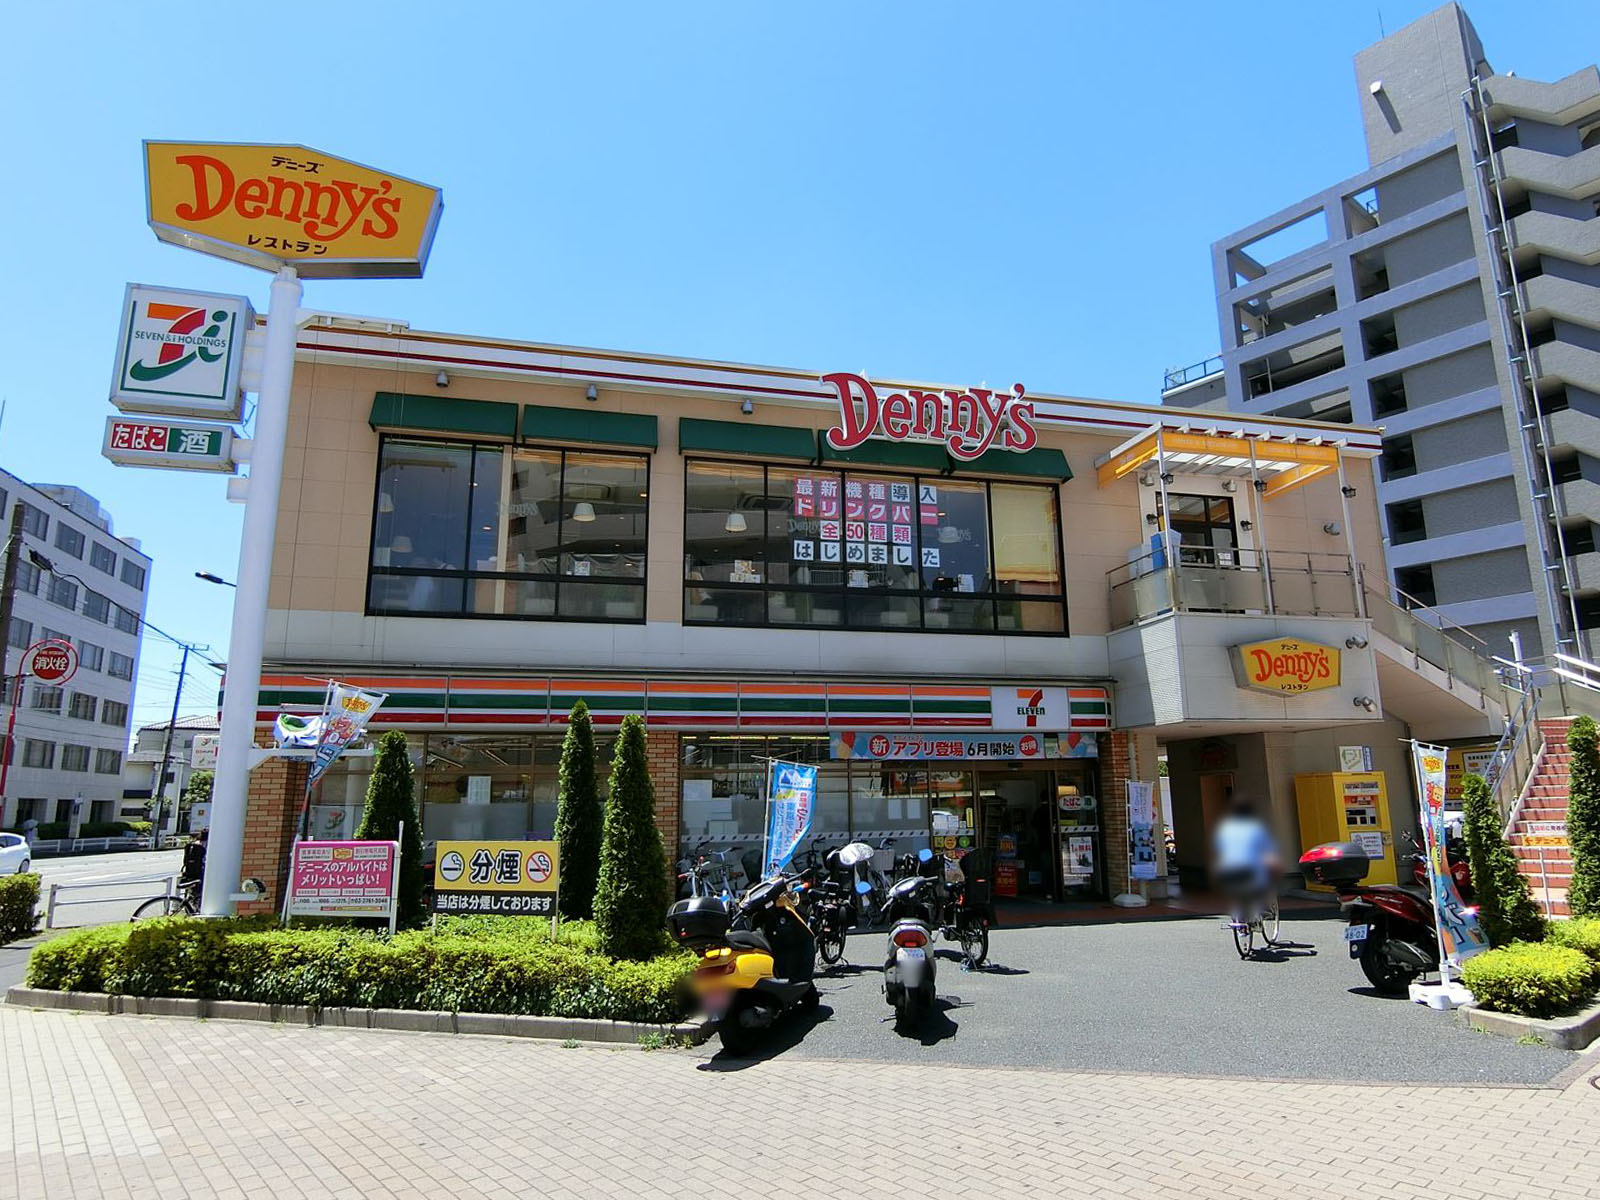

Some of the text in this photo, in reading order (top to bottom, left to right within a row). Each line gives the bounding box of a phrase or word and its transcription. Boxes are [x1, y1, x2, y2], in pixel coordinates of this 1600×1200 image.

[271, 155, 325, 174] デニーズ
[175, 154, 402, 242] Denny's
[247, 233, 327, 255] レストラン
[178, 335, 227, 349] HOLDINGS
[820, 371, 1038, 462] Denny's
[112, 424, 210, 455] たばこ 酒
[796, 478, 937, 504] 最新機種導入
[796, 499, 937, 524] ドリンクバー
[822, 523, 910, 542] 全50種類
[796, 543, 939, 565] はじめました
[35, 656, 67, 670] 消火栓
[1250, 648, 1330, 683] Denny's
[871, 738, 887, 753] 新
[893, 739, 964, 756] アプリ登場
[967, 742, 1015, 756] 6月開始
[298, 860, 388, 873] デニーズのアルバイトは
[469, 848, 523, 884] 分煙
[436, 894, 552, 911] 当店は分煙しております
